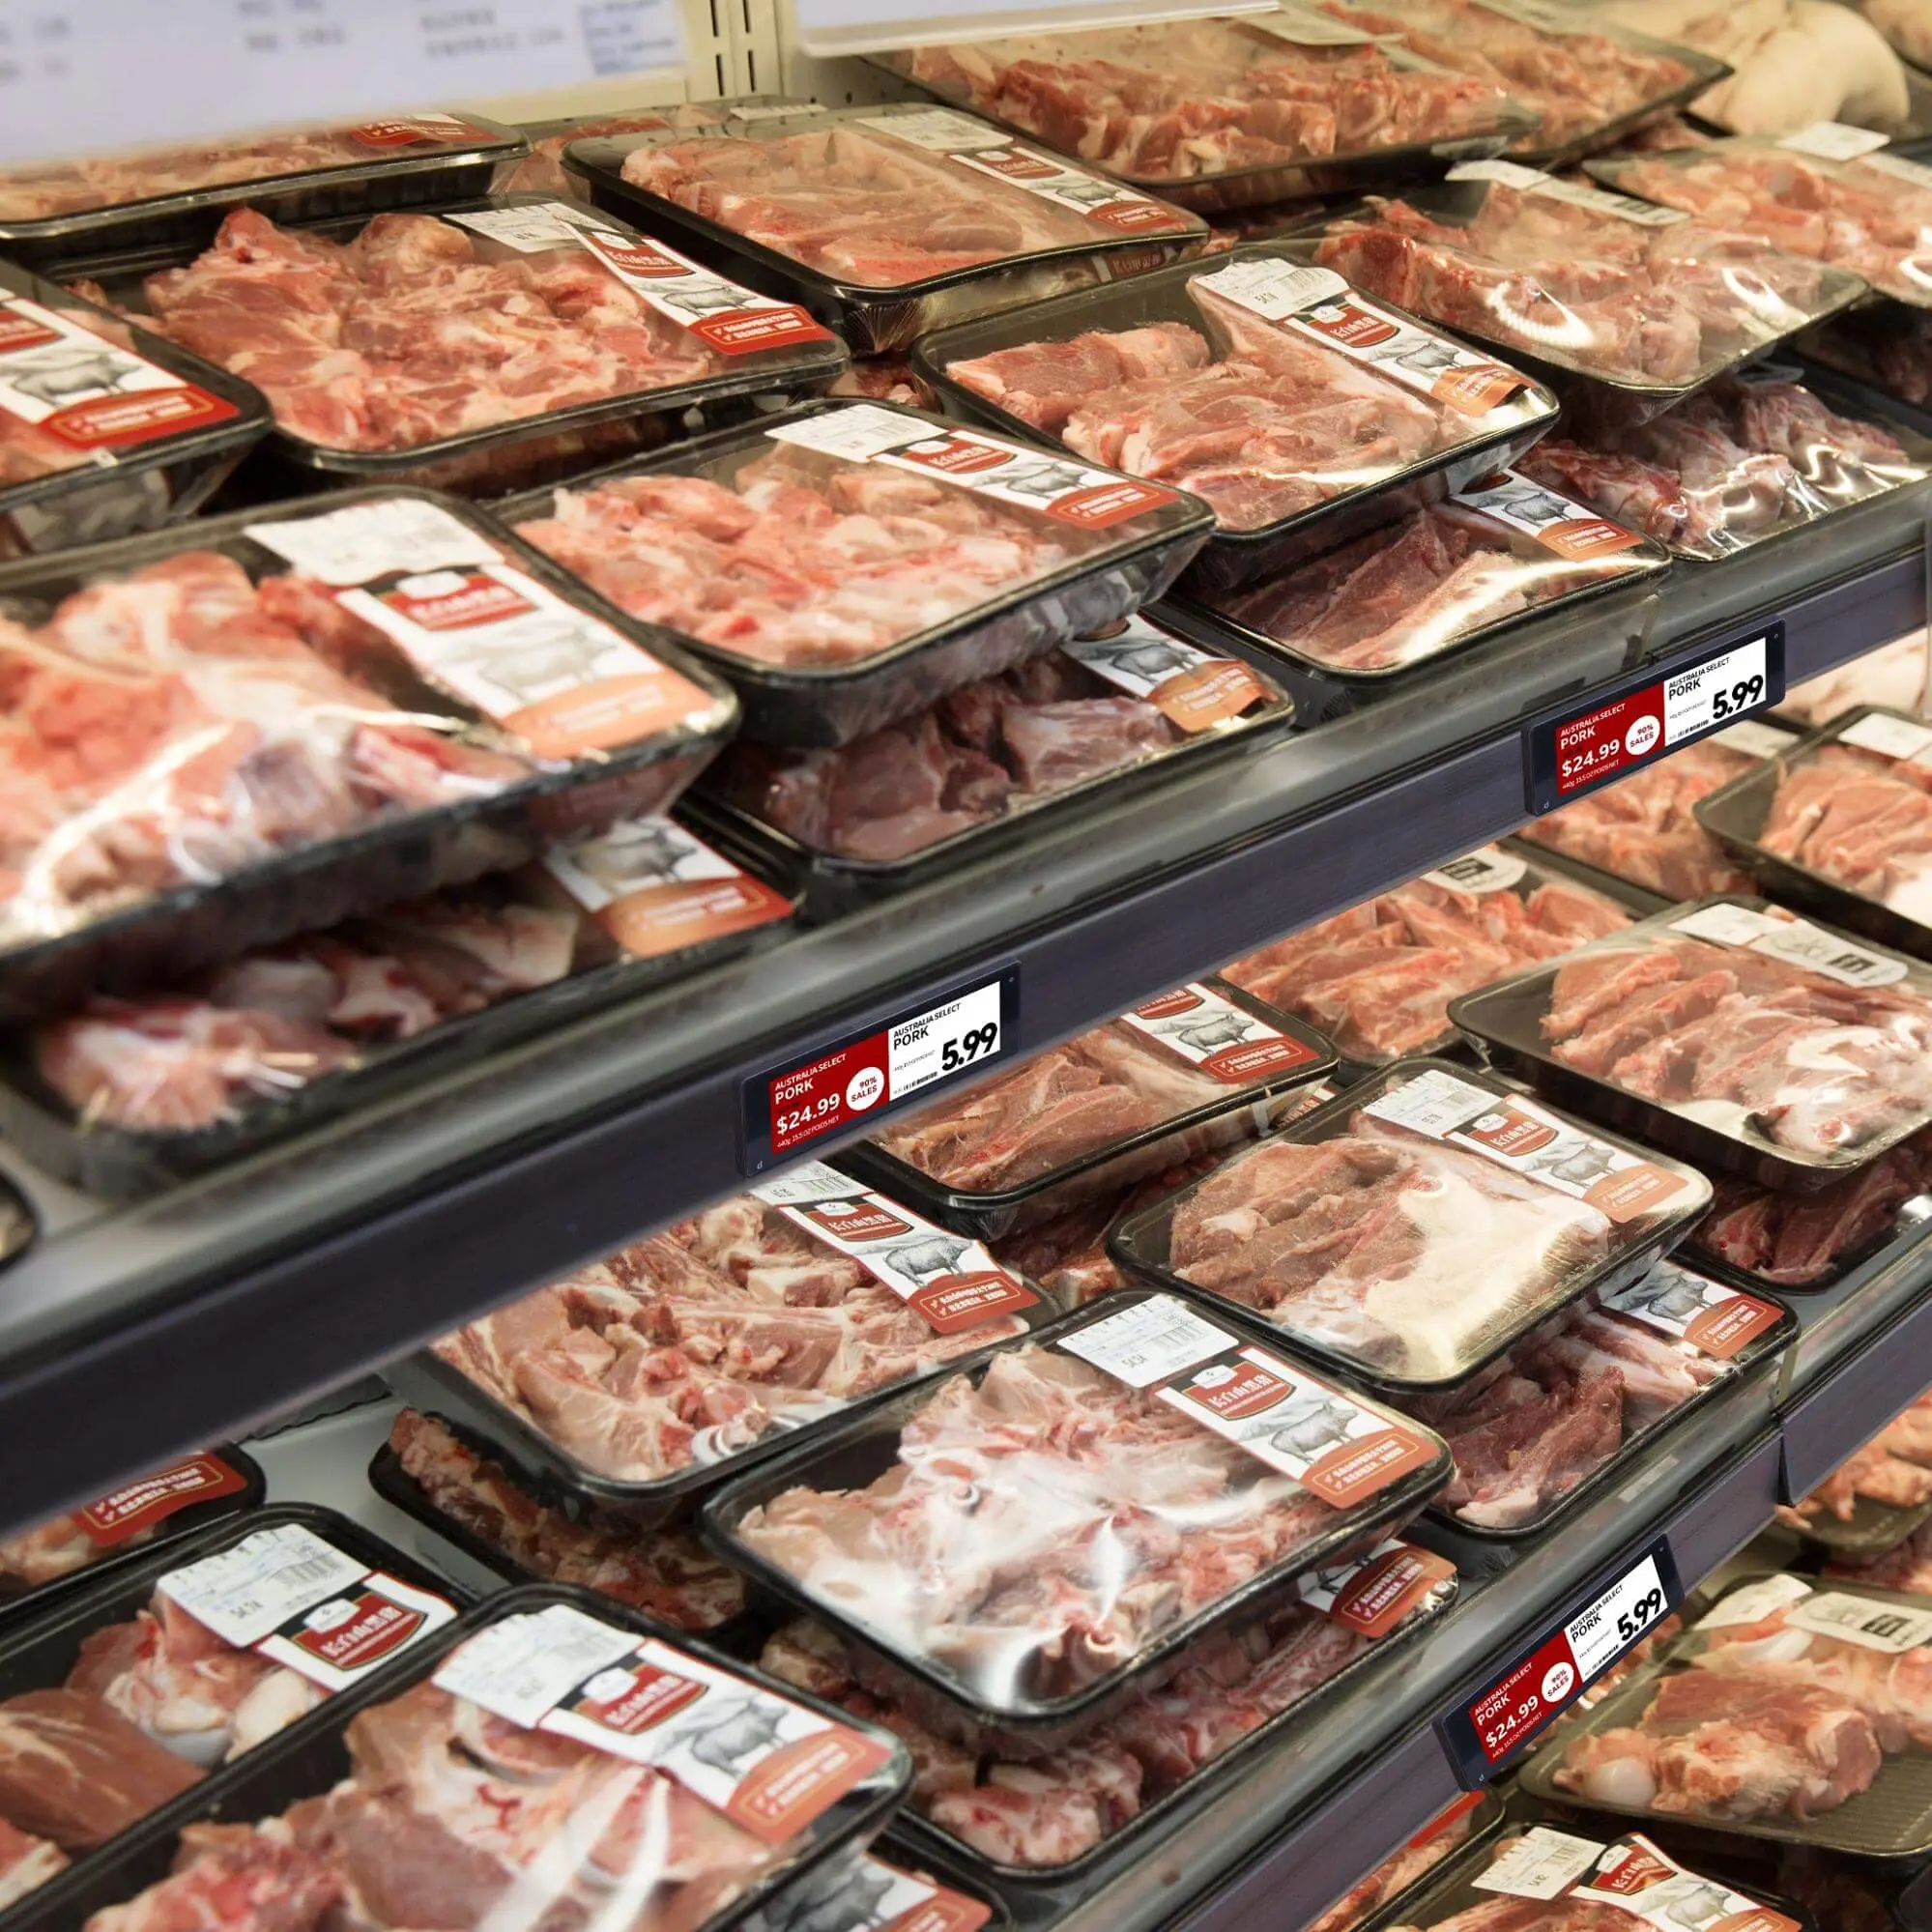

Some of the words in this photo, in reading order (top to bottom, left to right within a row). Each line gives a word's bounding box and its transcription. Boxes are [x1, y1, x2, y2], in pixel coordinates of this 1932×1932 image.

[1669, 668, 1705, 689] AUSTRALIA
[1706, 657, 1730, 673] SELECT
[1669, 678, 1701, 701] PORK
[1713, 675, 1764, 719] 5.99
[1561, 716, 1599, 737] AUSTRALIA
[1600, 703, 1626, 719] SELECT
[1637, 723, 1654, 735] 90%
[1561, 727, 1596, 750] PORK
[1629, 733, 1655, 747] SALES
[1562, 739, 1620, 778] $24.99
[894, 1015, 934, 1038] AUSTRALIA
[934, 1003, 961, 1021] SELECT
[894, 1025, 930, 1051] PORK
[942, 1023, 997, 1071] 5.99
[775, 1067, 818, 1091] AUSTRALIA
[818, 1053, 847, 1073] SELECT
[859, 1075, 878, 1089] 90%
[775, 1079, 814, 1105] PORK
[851, 1084, 878, 1103] SALES
[777, 1093, 840, 1135] $24.99
[1570, 1602, 1602, 1632] AUSTRALIA
[1601, 1585, 1624, 1610] SELECT
[1618, 1588, 1661, 1641] 5.99
[1572, 1614, 1602, 1643] PORK
[1475, 1683, 1509, 1715] AUSTRALIA
[1508, 1662, 1532, 1687] SELECT
[1547, 1675, 1570, 1697] SALES
[1477, 1693, 1512, 1726] PORK
[1485, 1695, 1539, 1748] $24.99
